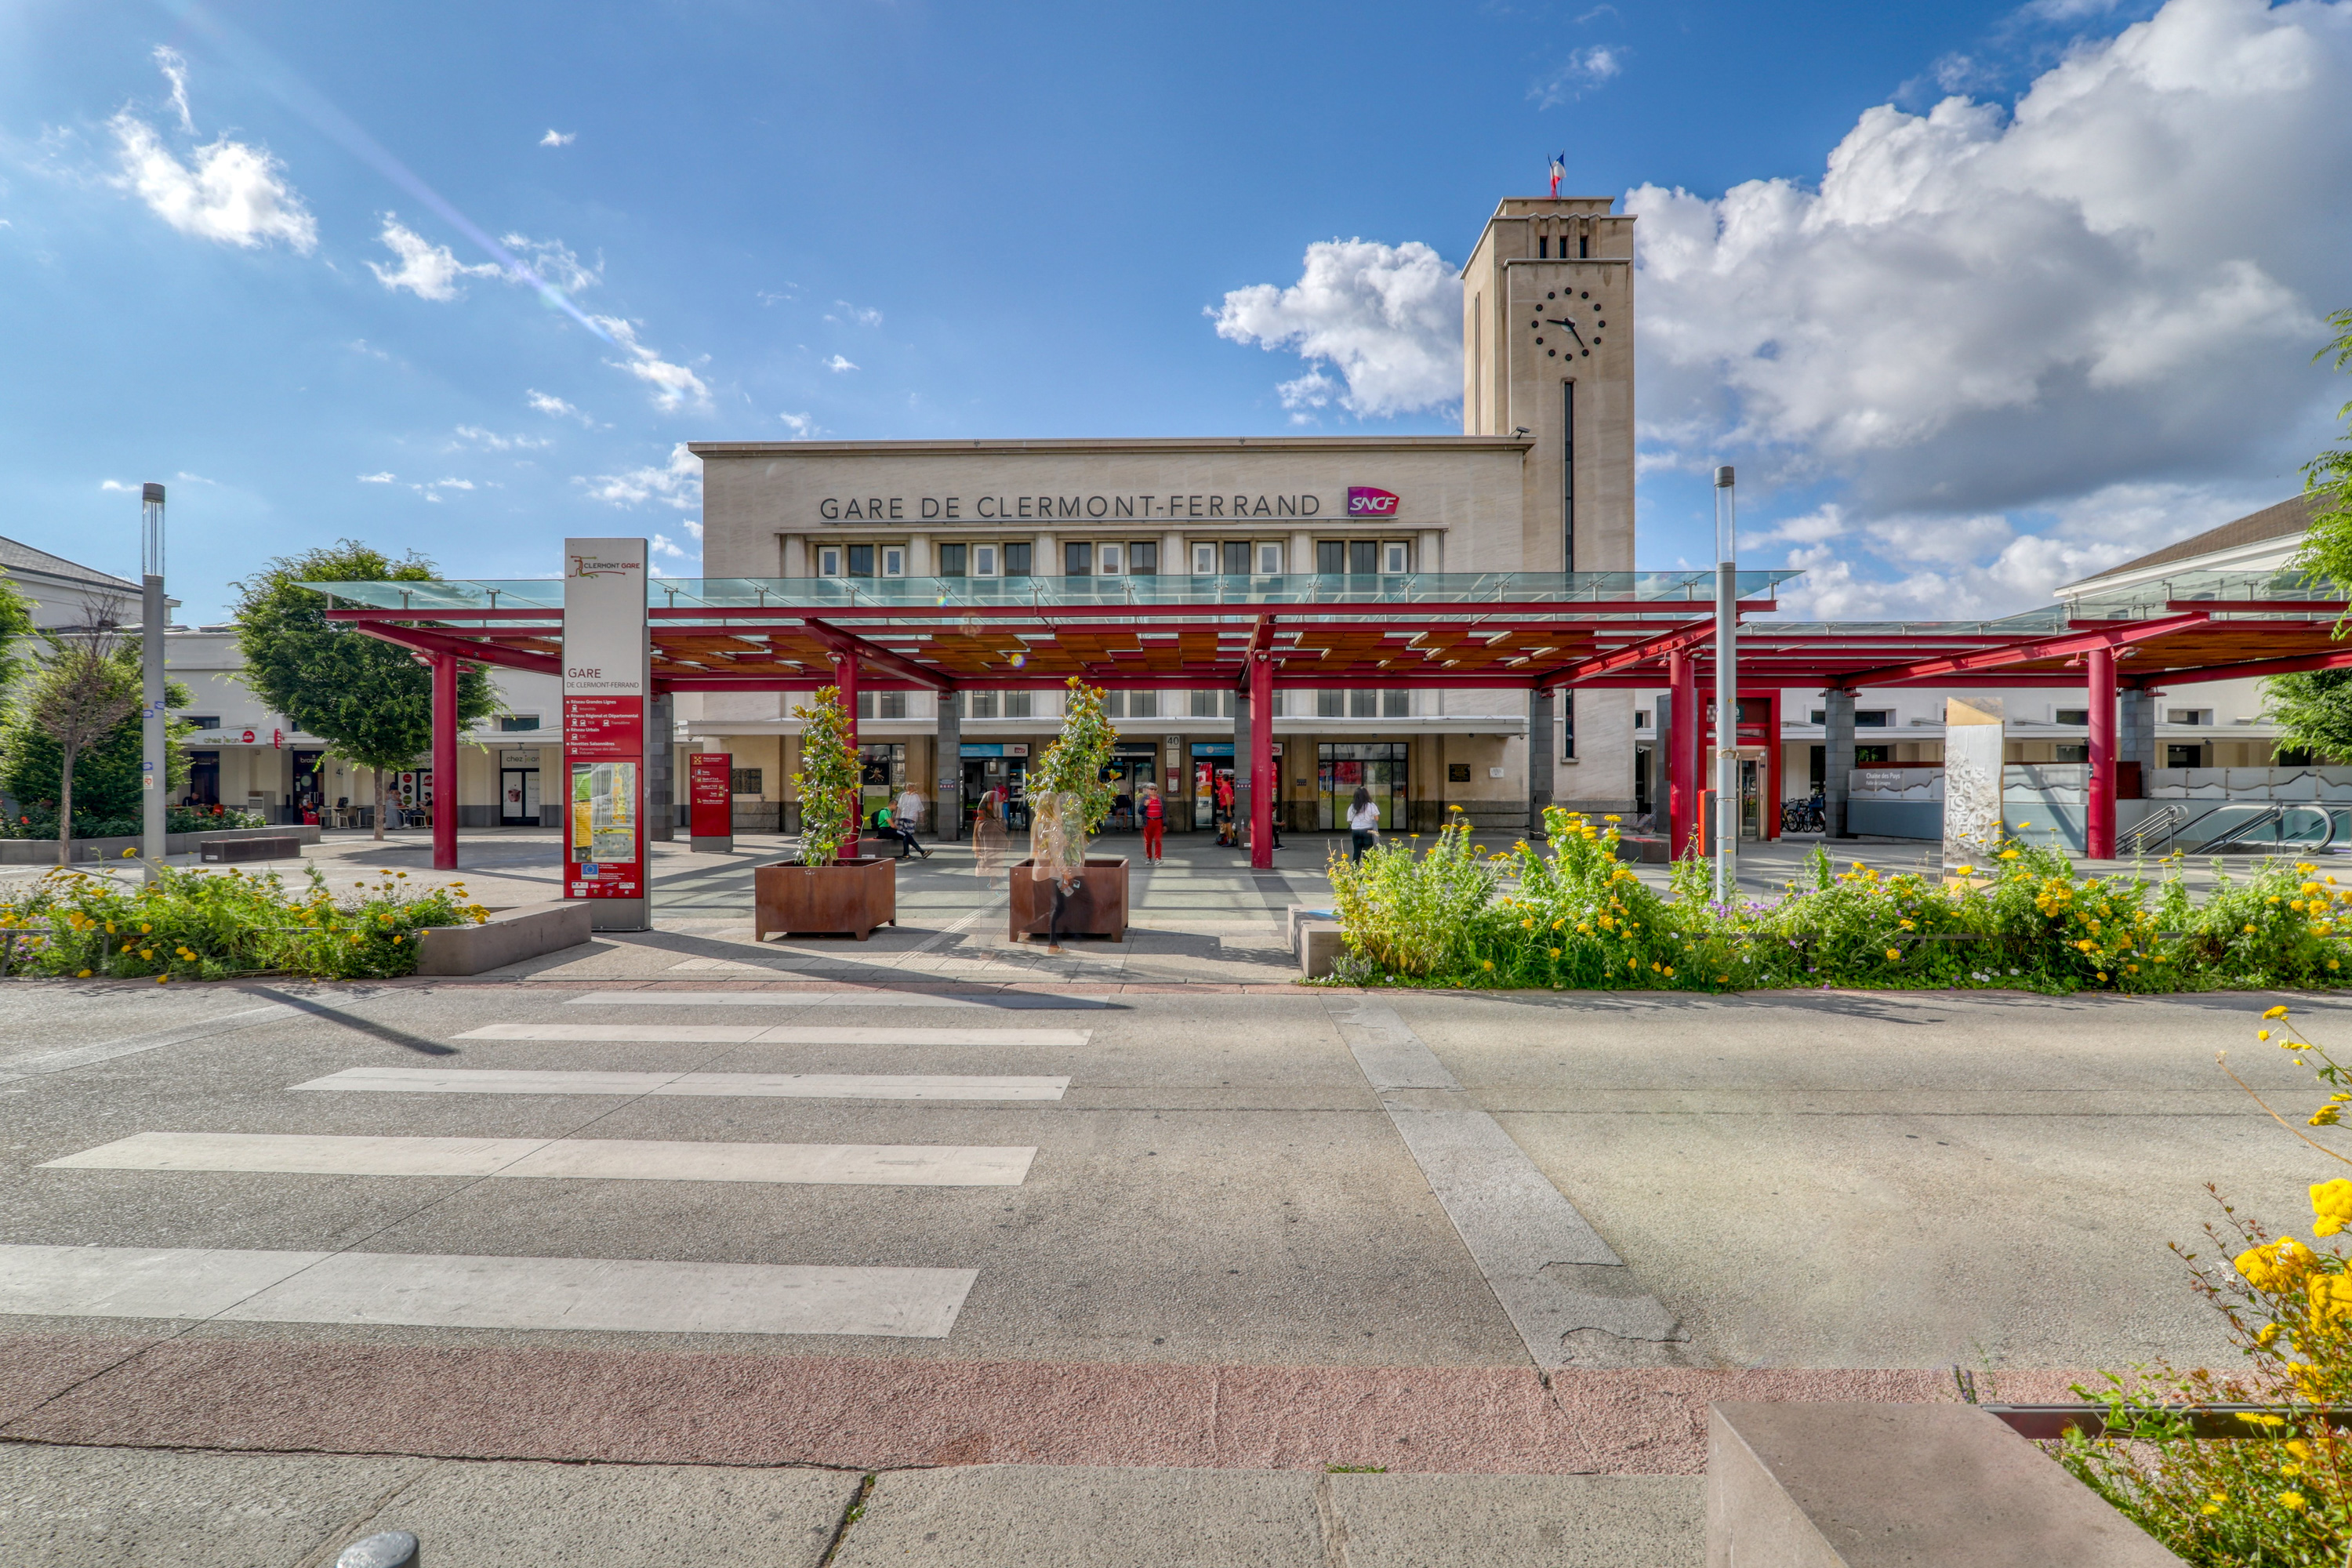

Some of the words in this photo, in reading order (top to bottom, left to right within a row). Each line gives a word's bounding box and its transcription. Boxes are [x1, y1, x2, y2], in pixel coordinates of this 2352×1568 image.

[820, 497, 904, 520] GARE
[921, 497, 960, 518] DE
[977, 495, 1320, 518] CLERMONT-FERRAND
[1348, 496, 1398, 512] SNCF
[568, 667, 601, 679] GARE
[203, 735, 222, 744] chez
[223, 735, 241, 745] jean
[1167, 736, 1179, 746] 40
[524, 755, 539, 764] jean
[1889, 771, 1900, 780] Puys
